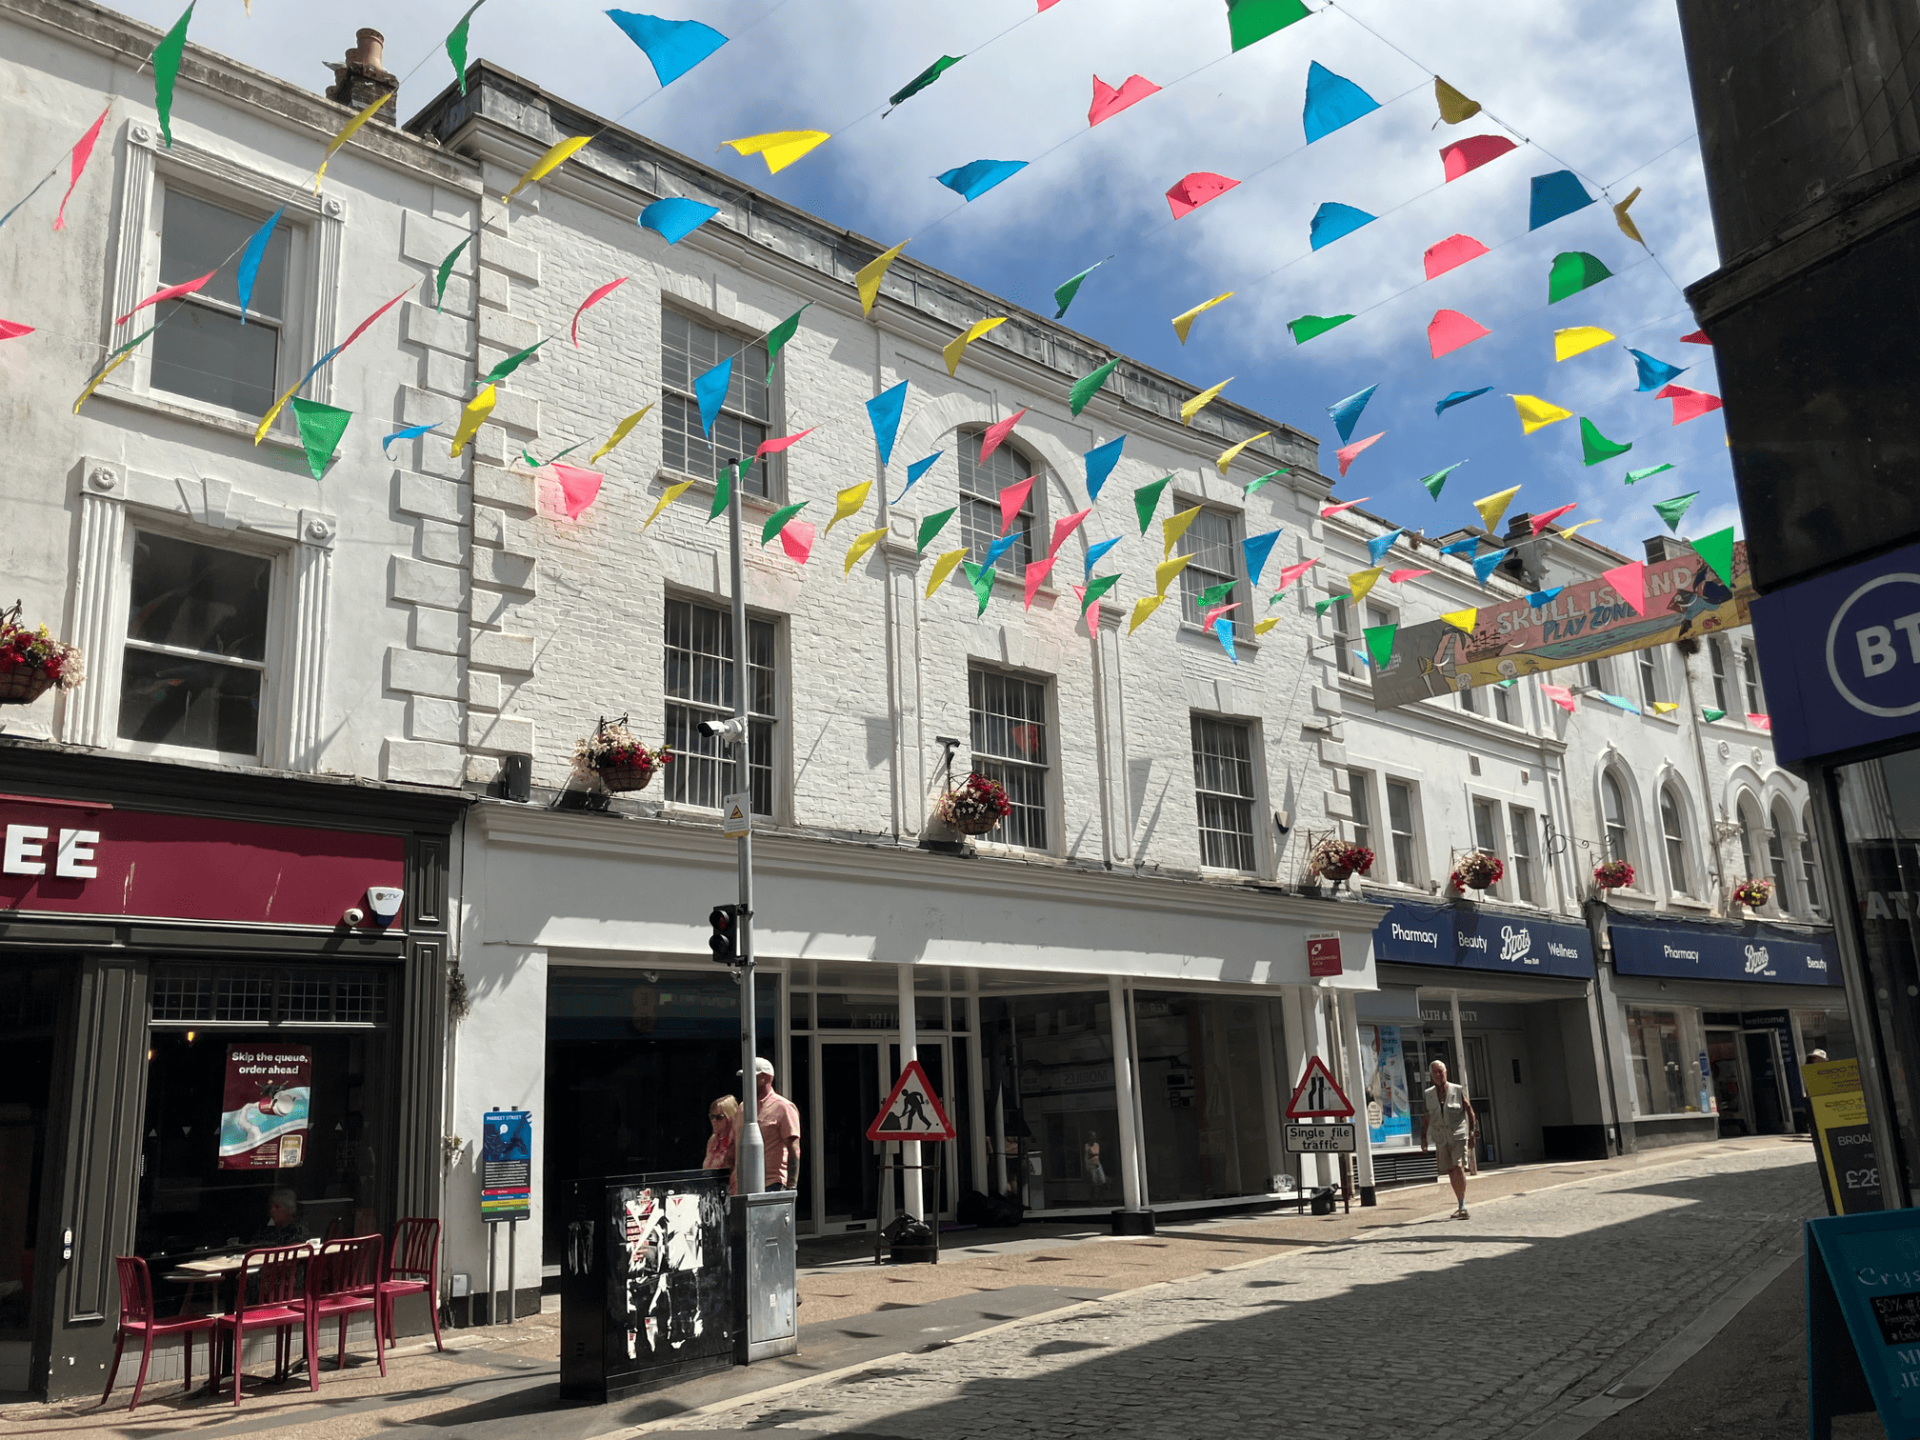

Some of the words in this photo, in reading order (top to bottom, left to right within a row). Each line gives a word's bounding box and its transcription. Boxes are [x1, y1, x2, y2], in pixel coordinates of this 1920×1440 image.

[1496, 593, 1585, 635] SKULL
[1542, 615, 1588, 643] PLAY
[1856, 611, 1920, 678] BT
[3, 824, 101, 880] EE
[1391, 923, 1438, 949] Pharmacy
[1457, 931, 1488, 953] Beauty
[1500, 925, 1532, 962] Boots
[1547, 942, 1578, 959] Wellness
[1663, 945, 1699, 963] Pharmacy
[1744, 944, 1769, 975] Boots
[1806, 956, 1828, 972] Beauty
[1420, 1009, 1441, 1021] ALTH
[1744, 1015, 1785, 1026] welcome
[231, 1052, 255, 1063] Skip
[256, 1052, 274, 1062] the
[274, 1054, 308, 1064] queue,
[238, 1065, 267, 1074] order
[267, 1065, 299, 1074] ahead
[1290, 1127, 1325, 1140] Single
[1331, 1126, 1350, 1138] file
[1302, 1139, 1339, 1150] traffic
[1875, 1297, 1903, 1314] 50%
